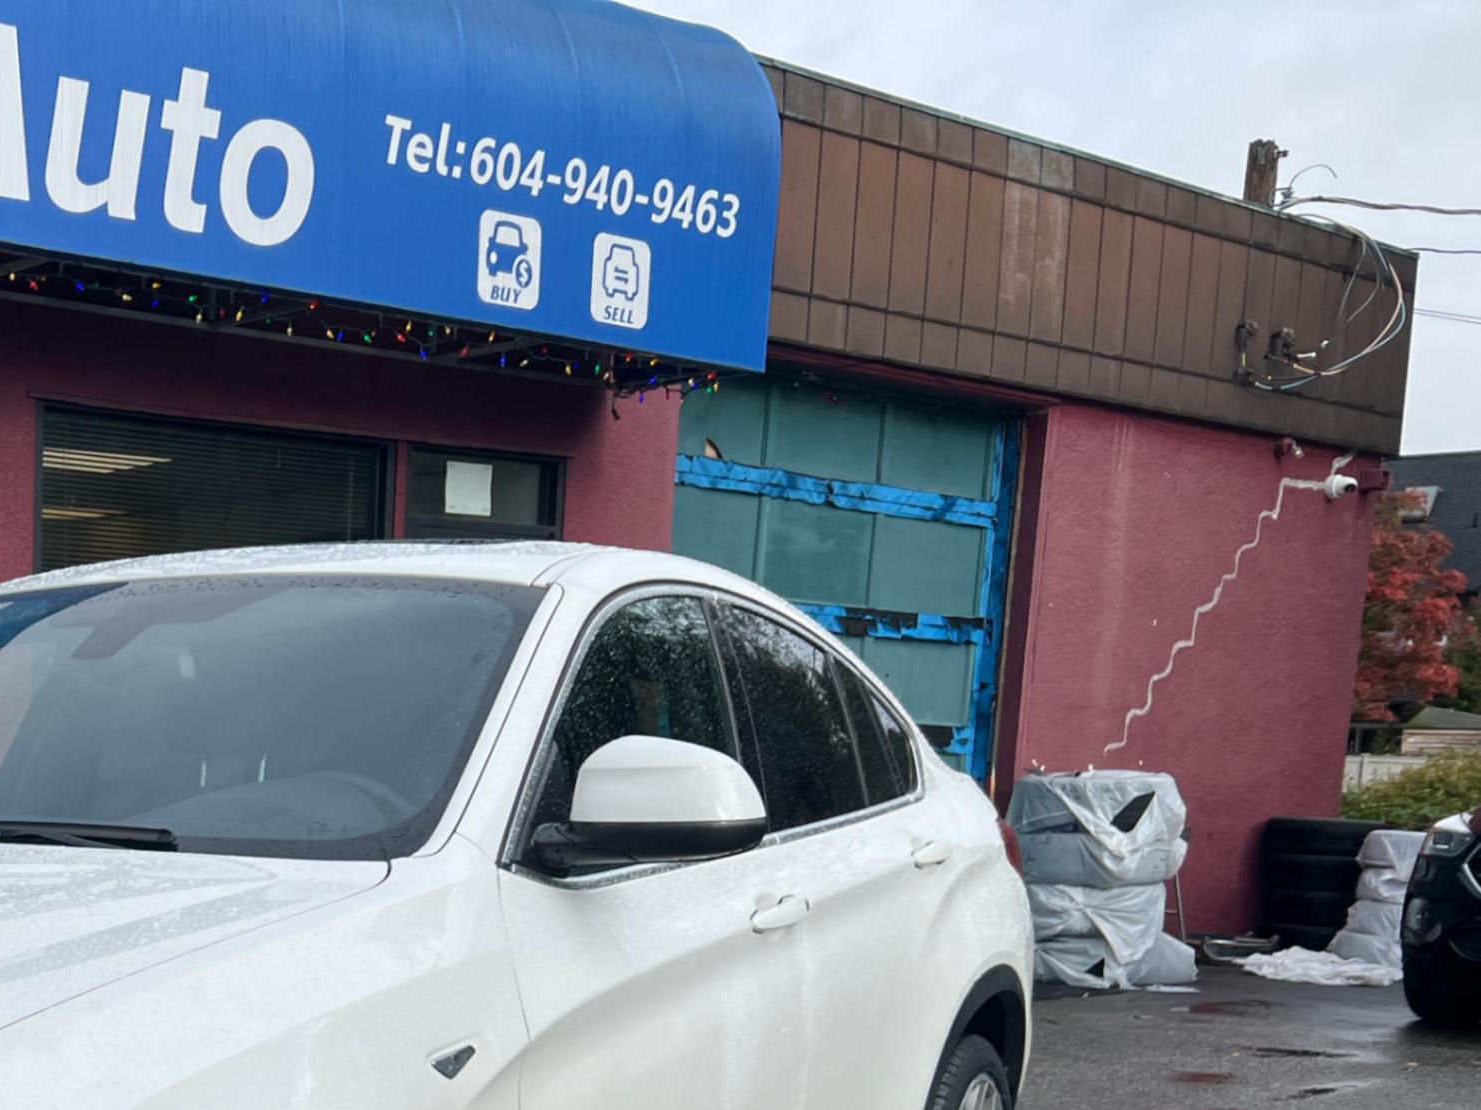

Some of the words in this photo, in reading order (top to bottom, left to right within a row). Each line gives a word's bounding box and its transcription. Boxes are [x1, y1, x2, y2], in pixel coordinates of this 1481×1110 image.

[385, 114, 740, 238] Tel:604-940-9463
[490, 284, 523, 304] BUY
[603, 305, 634, 325] SELL
